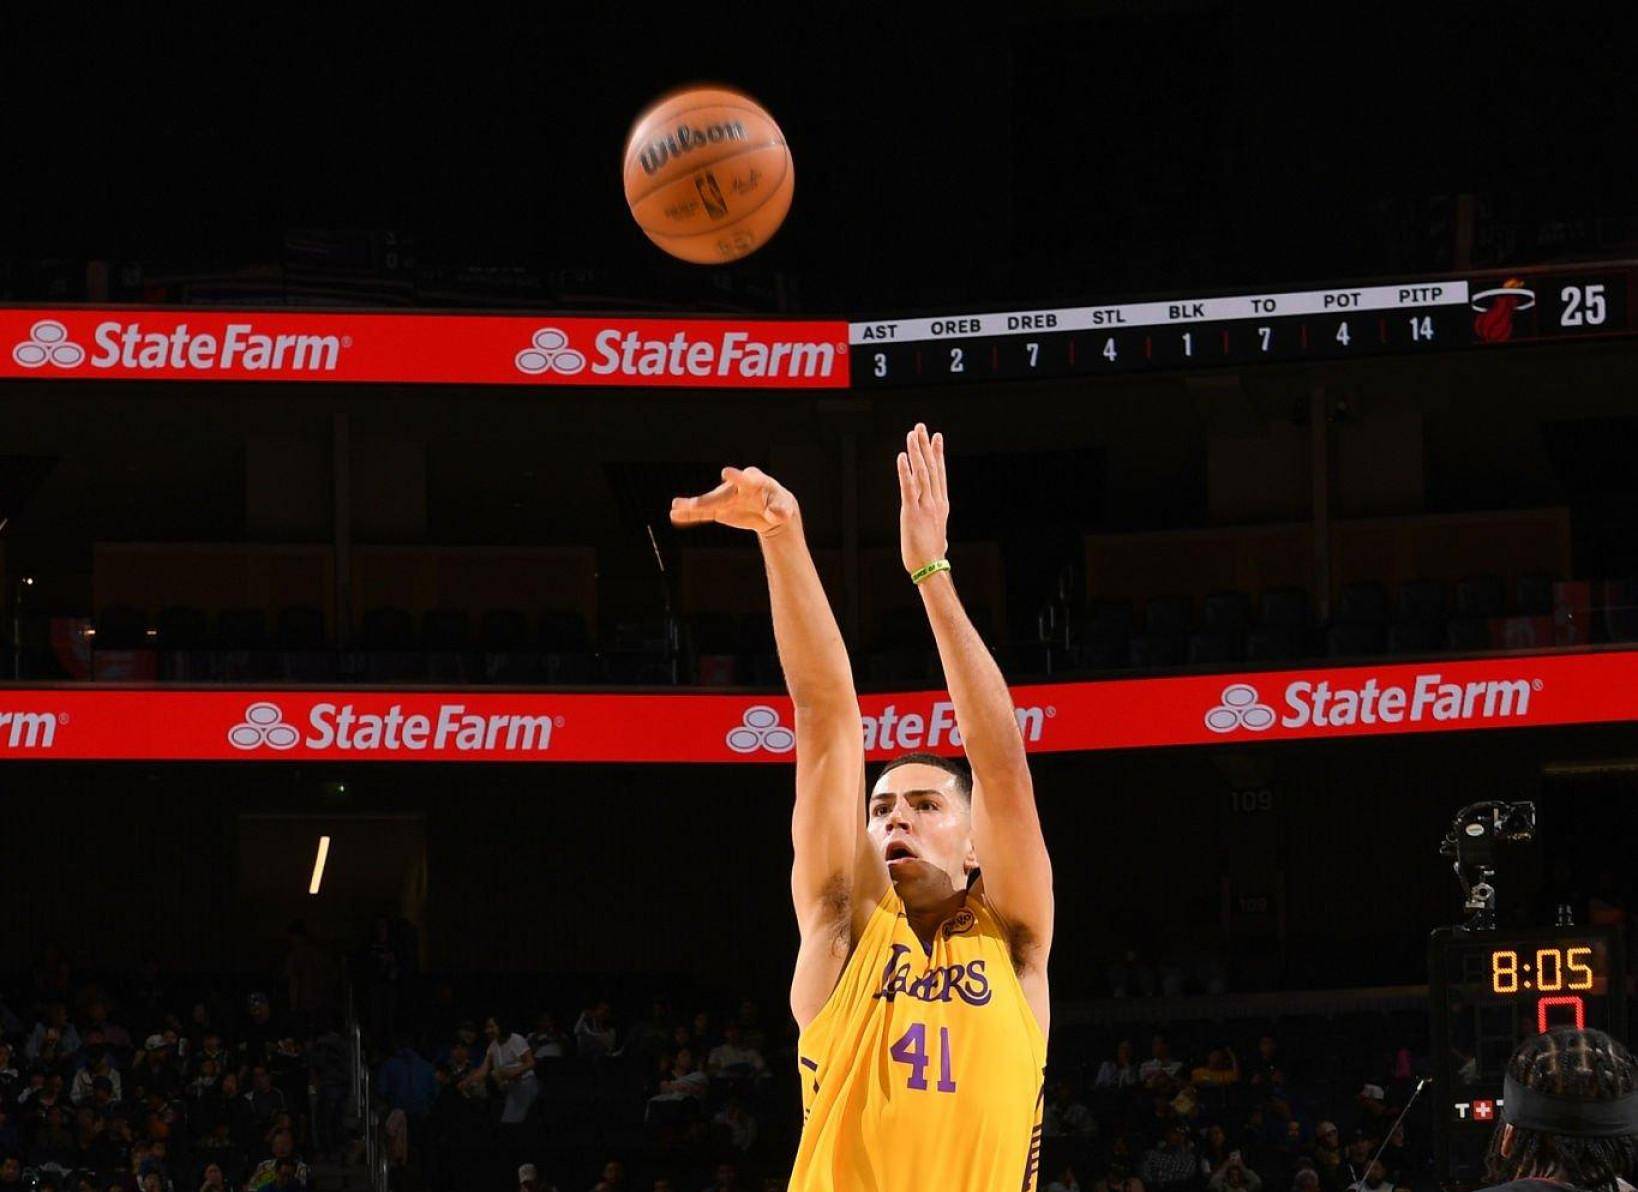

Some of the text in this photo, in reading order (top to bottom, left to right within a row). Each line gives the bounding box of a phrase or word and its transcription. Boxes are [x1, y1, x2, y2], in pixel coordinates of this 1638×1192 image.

[639, 121, 745, 175] Wilson
[862, 287, 1443, 340] AST OREB DREB STL BLK TO POT PITP
[1560, 284, 1606, 327] 25
[874, 315, 1434, 378] 3 2 7 4 1 7 4 14
[1492, 947, 1593, 993] 8:05
[890, 1023, 956, 1093] 41
